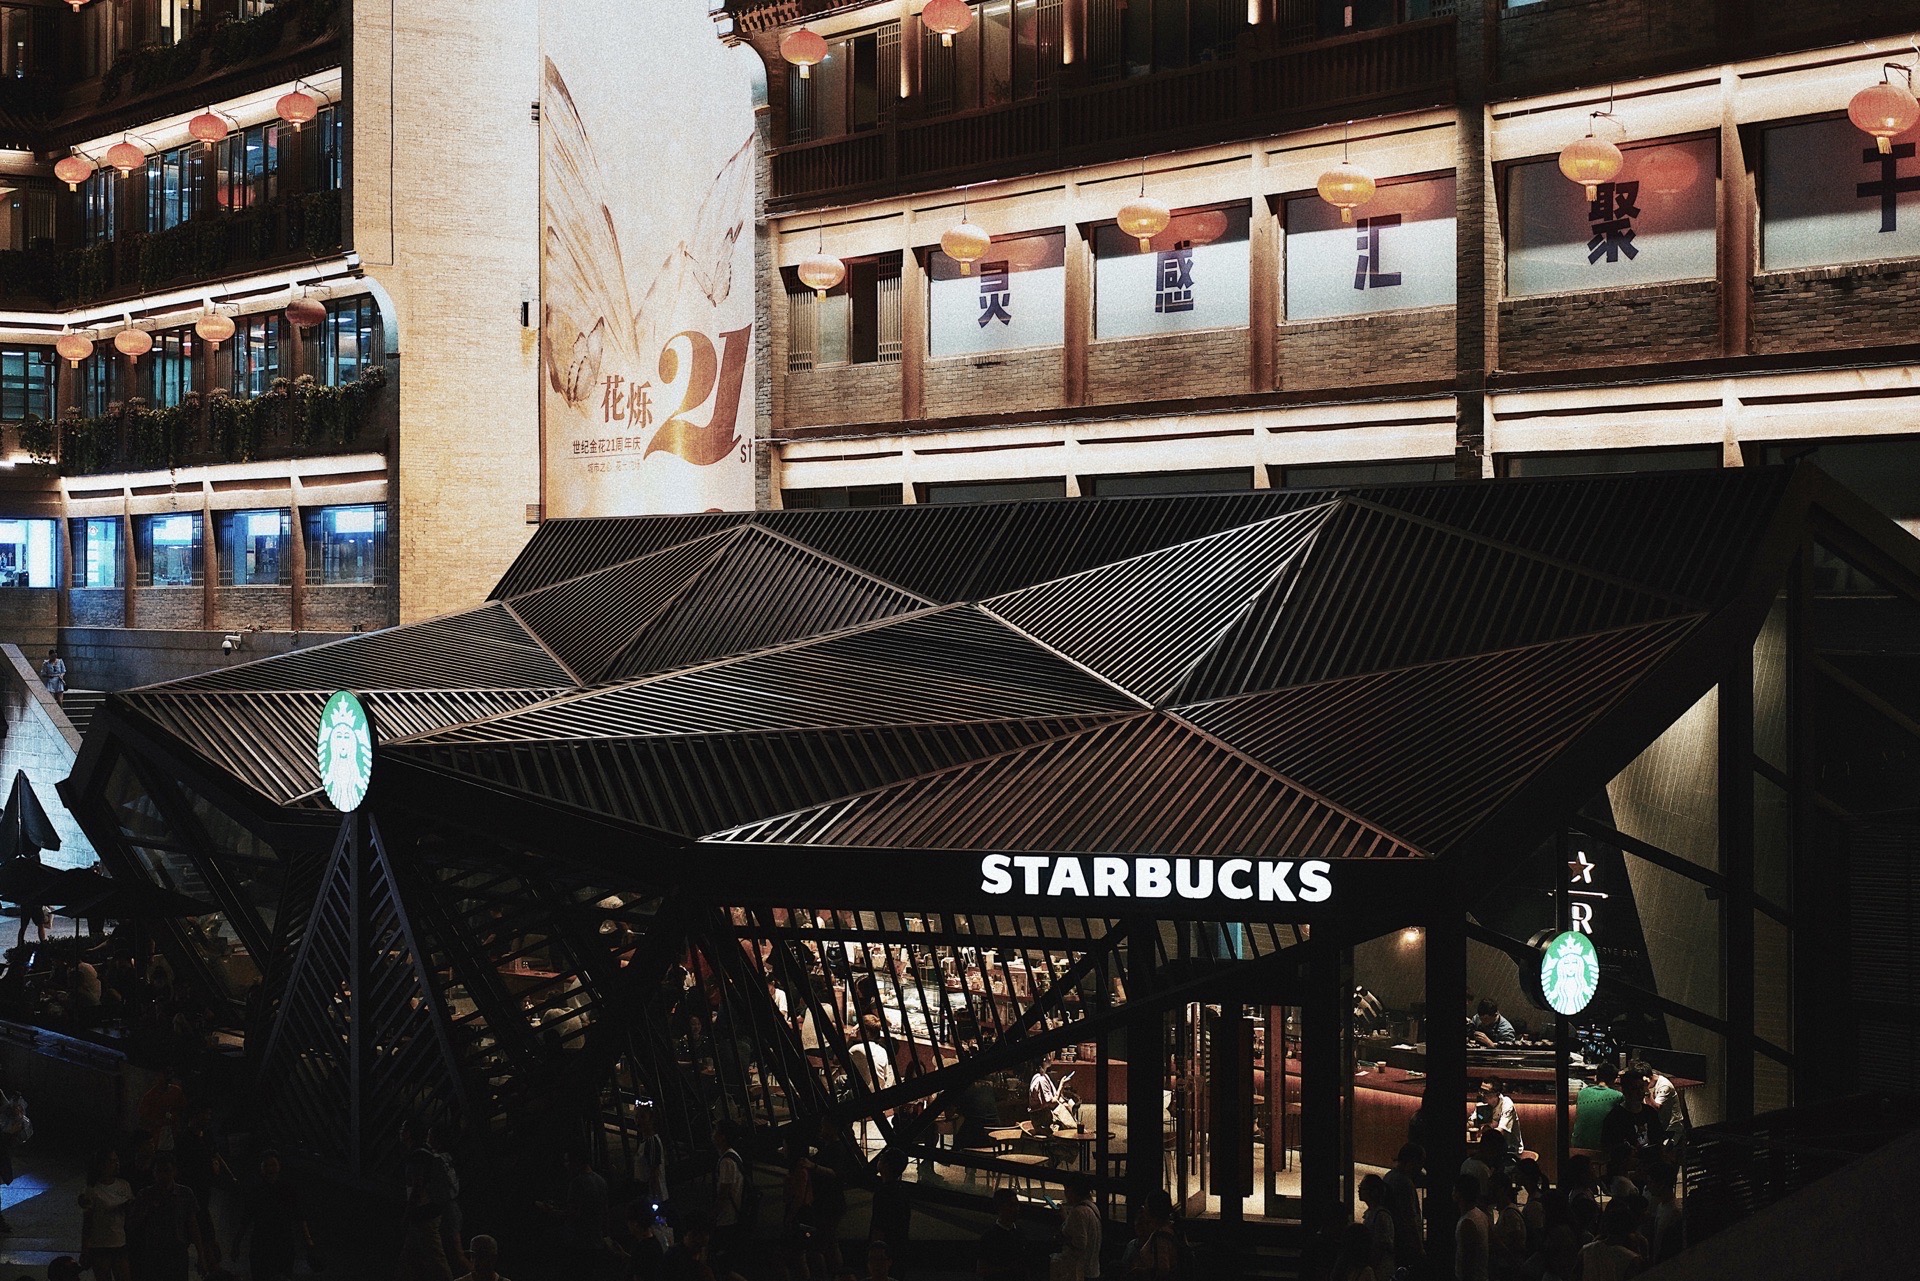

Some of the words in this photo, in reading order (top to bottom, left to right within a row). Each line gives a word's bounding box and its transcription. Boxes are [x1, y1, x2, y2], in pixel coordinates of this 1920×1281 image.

[978, 260, 1011, 328] 灵
[1155, 240, 1194, 313] 感
[1354, 213, 1401, 290] 汇
[1587, 181, 1641, 265] 聚
[600, 374, 653, 430] 花烁
[572, 436, 641, 454] 世纪金花21周年庆
[980, 854, 1333, 903] STARBUCKS
[1571, 902, 1593, 934] R
